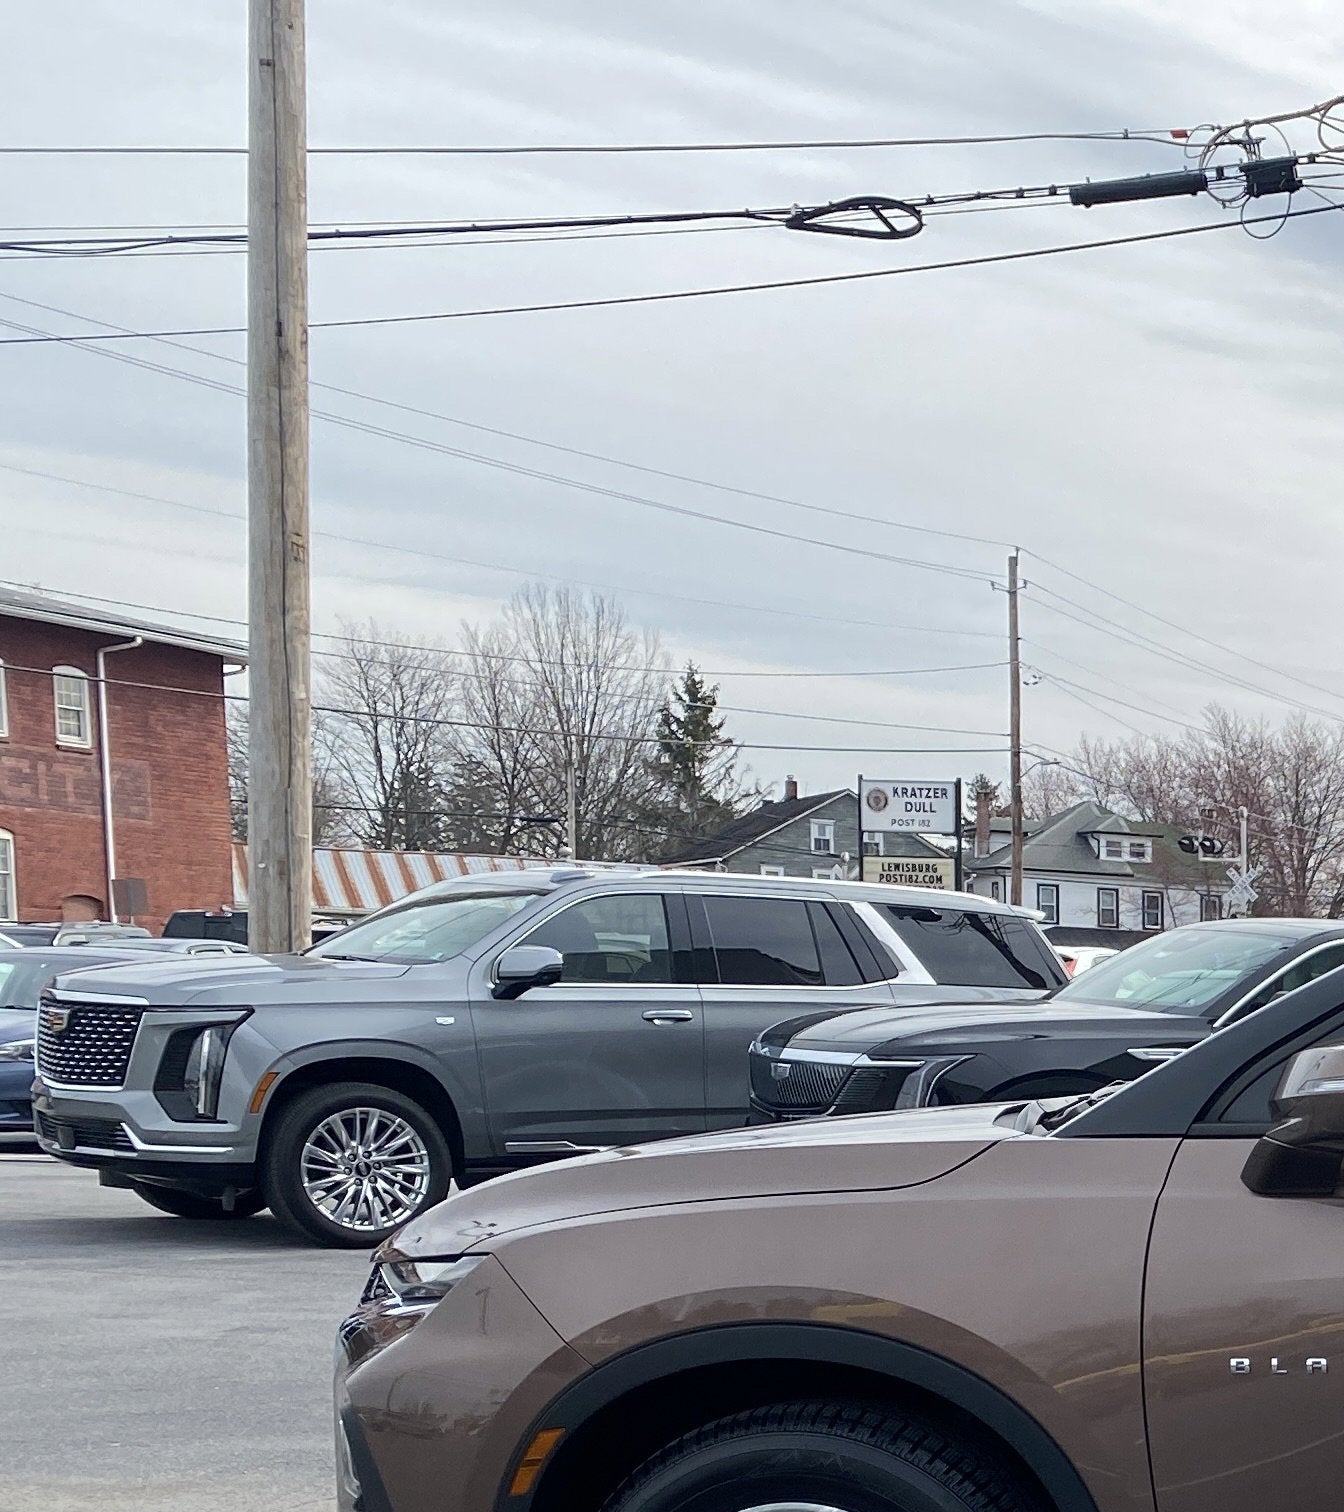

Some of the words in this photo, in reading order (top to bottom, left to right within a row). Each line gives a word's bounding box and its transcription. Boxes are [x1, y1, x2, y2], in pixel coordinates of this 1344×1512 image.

[892, 786, 948, 799] KRATZER
[904, 801, 936, 813] DULL
[891, 818, 915, 827] POST
[918, 819, 931, 827] 182
[881, 862, 938, 873] LEWISBURG
[879, 873, 943, 884] POST182.COM
